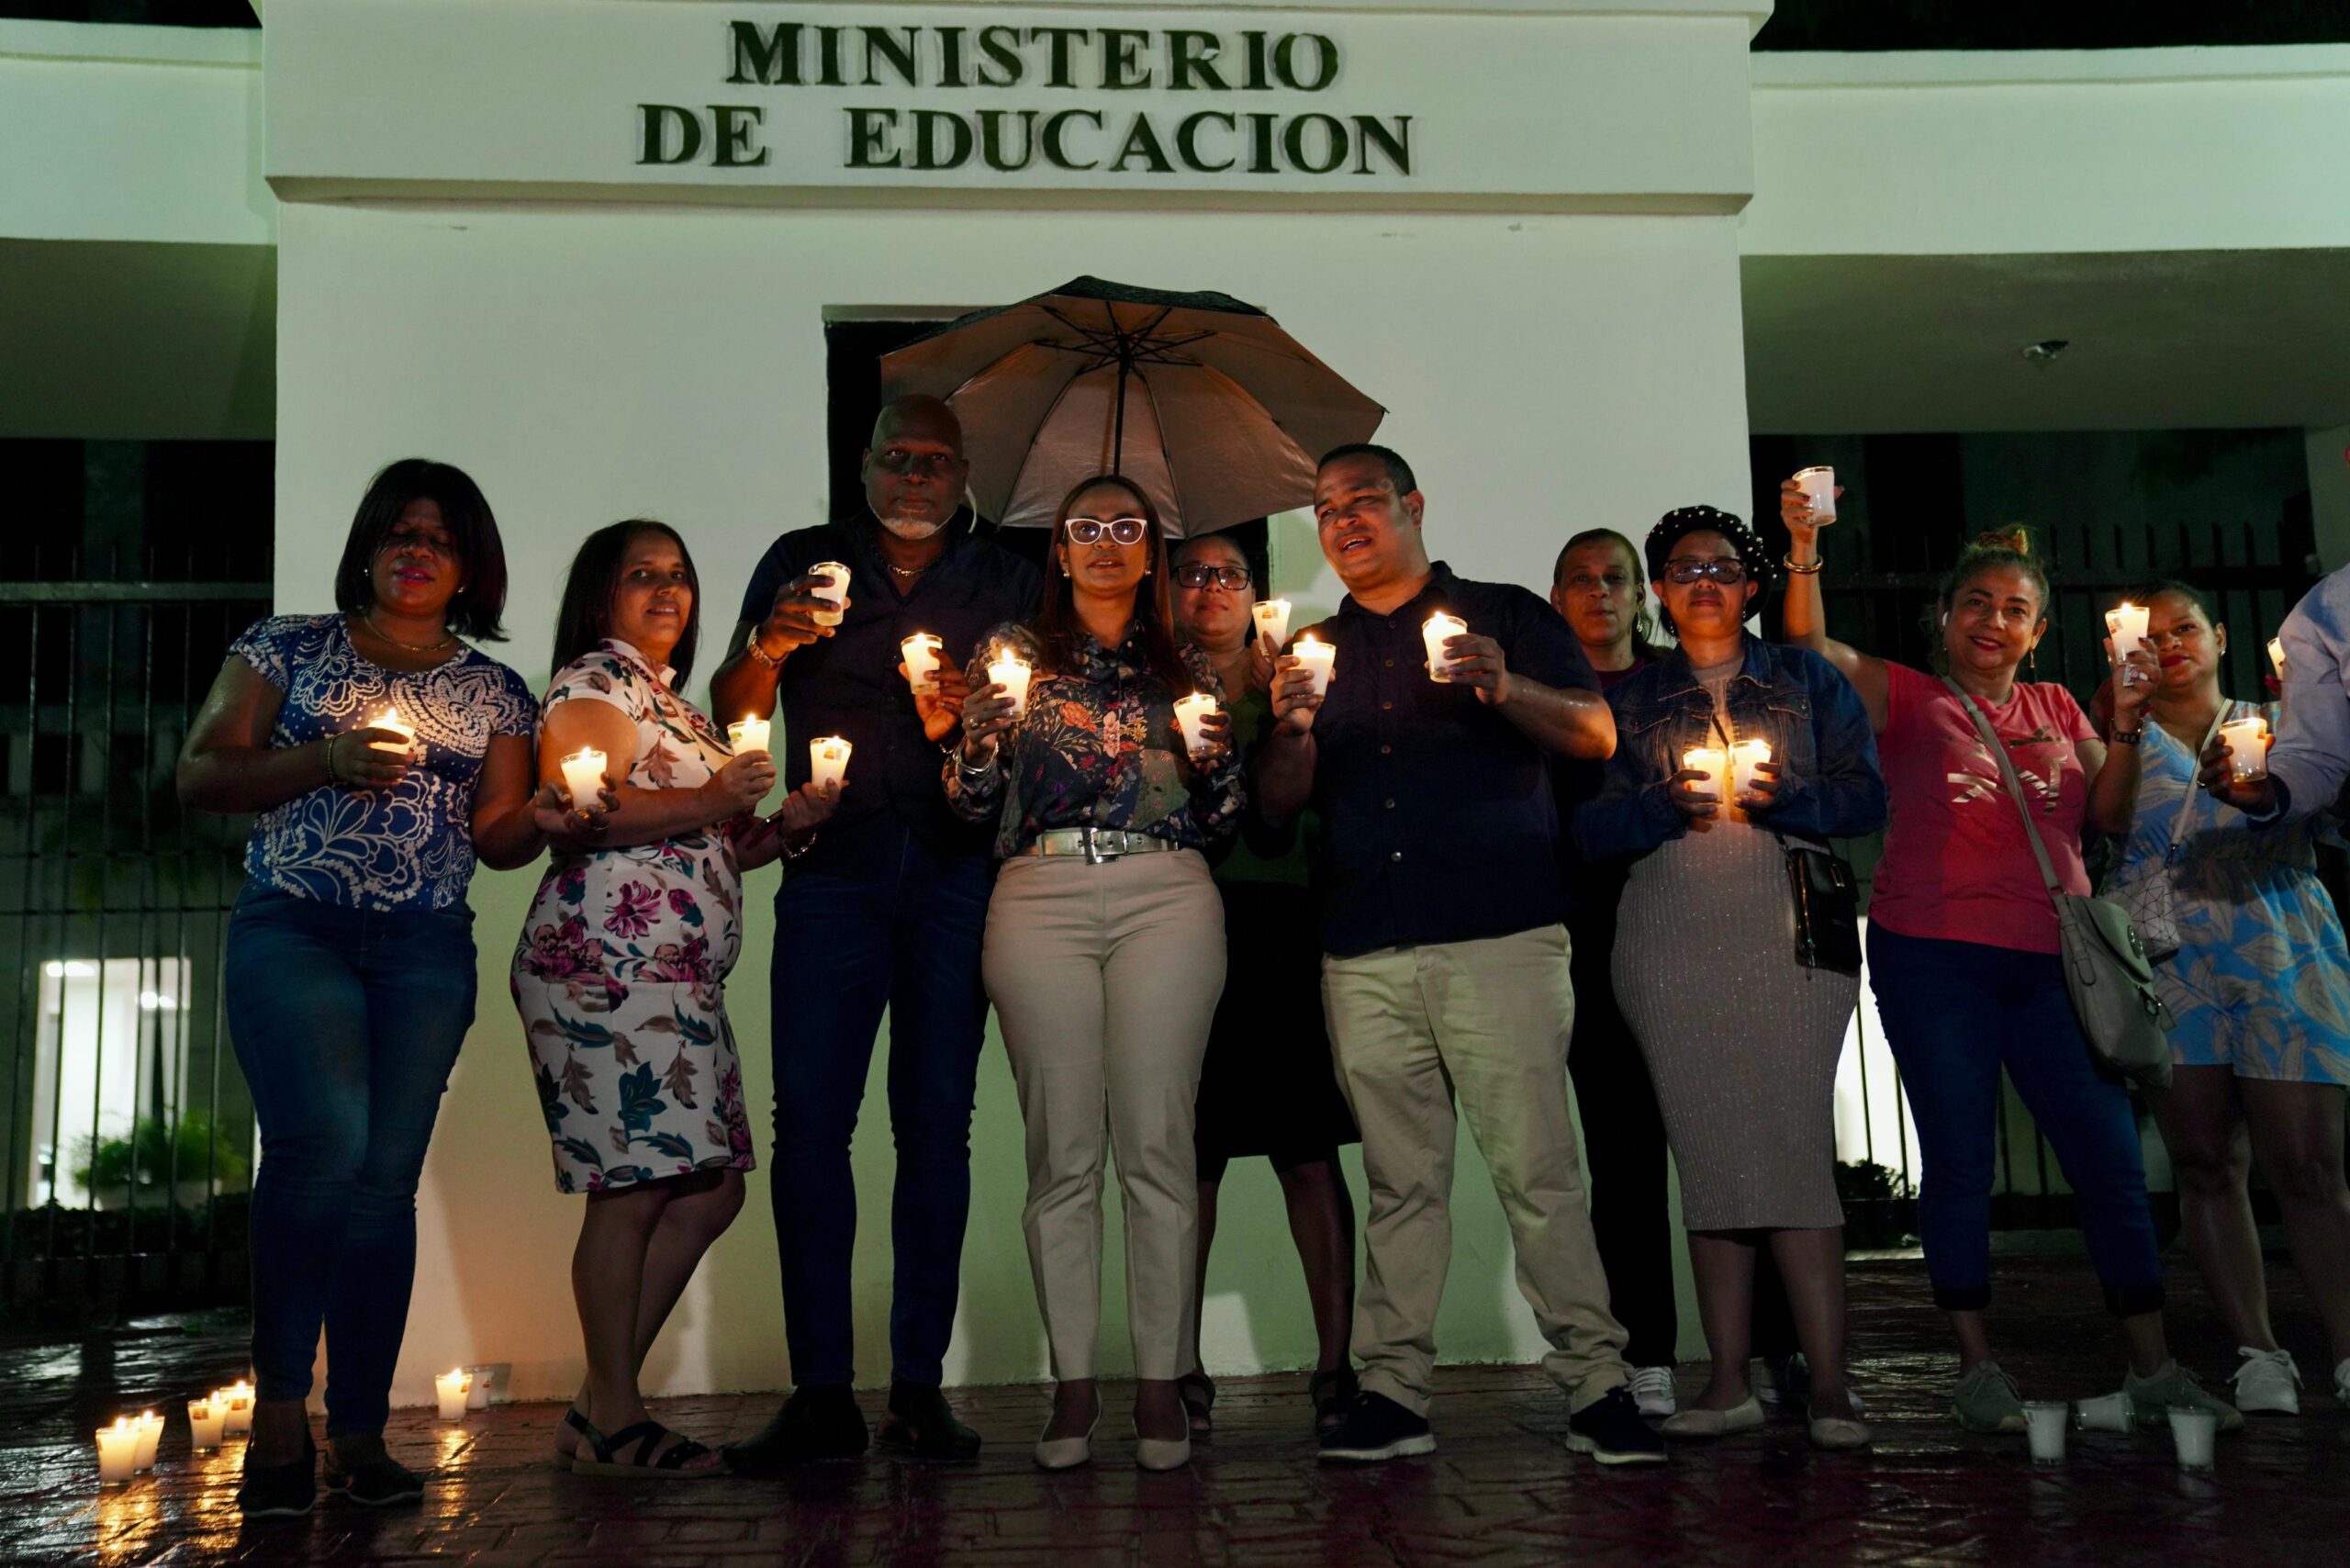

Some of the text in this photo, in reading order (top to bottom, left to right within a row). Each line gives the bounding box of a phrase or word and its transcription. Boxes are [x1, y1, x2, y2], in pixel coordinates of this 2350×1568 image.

[726, 20, 1338, 91] MINISTERIO
[635, 104, 1414, 176] DE EDUCACION
